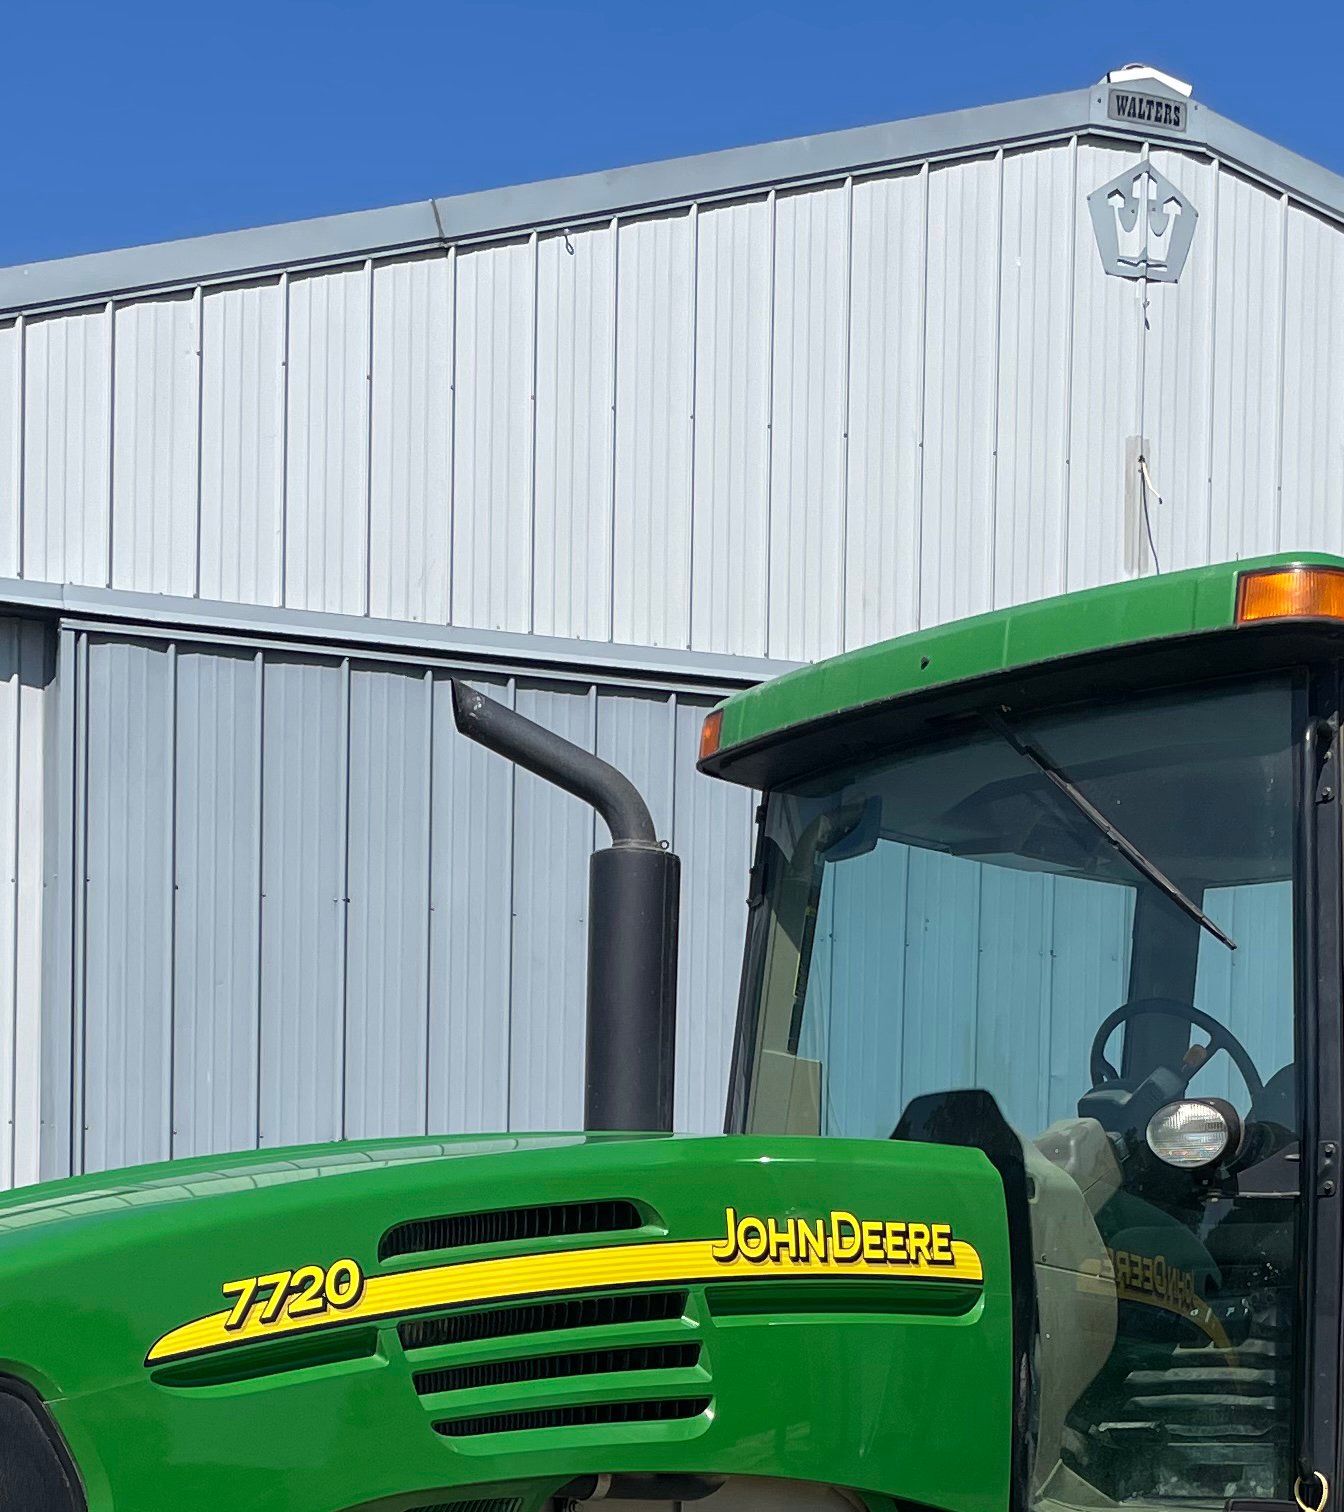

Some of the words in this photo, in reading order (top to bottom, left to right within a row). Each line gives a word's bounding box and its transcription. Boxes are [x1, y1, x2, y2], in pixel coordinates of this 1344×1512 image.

[1116, 95, 1181, 127] WALTERS
[712, 1207, 829, 1263] JOHN
[830, 1210, 954, 1266] DEERE
[222, 1258, 365, 1331] 7720
